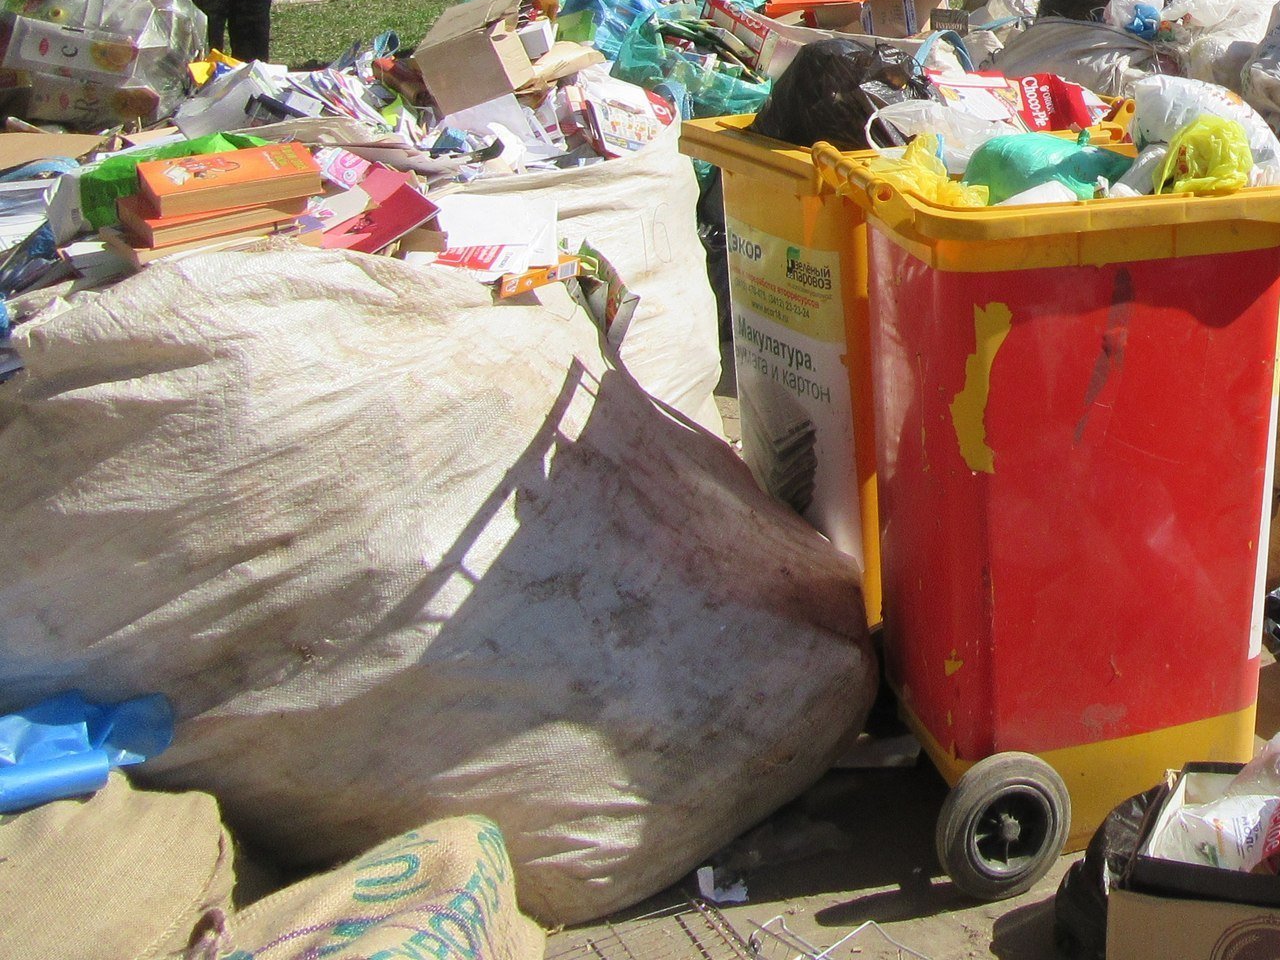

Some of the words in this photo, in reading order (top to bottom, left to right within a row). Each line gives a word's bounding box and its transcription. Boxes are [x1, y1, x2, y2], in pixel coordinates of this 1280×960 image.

[738, 314, 816, 372] Макулатура.
[772, 364, 778, 382] и
[782, 368, 831, 403] картон
